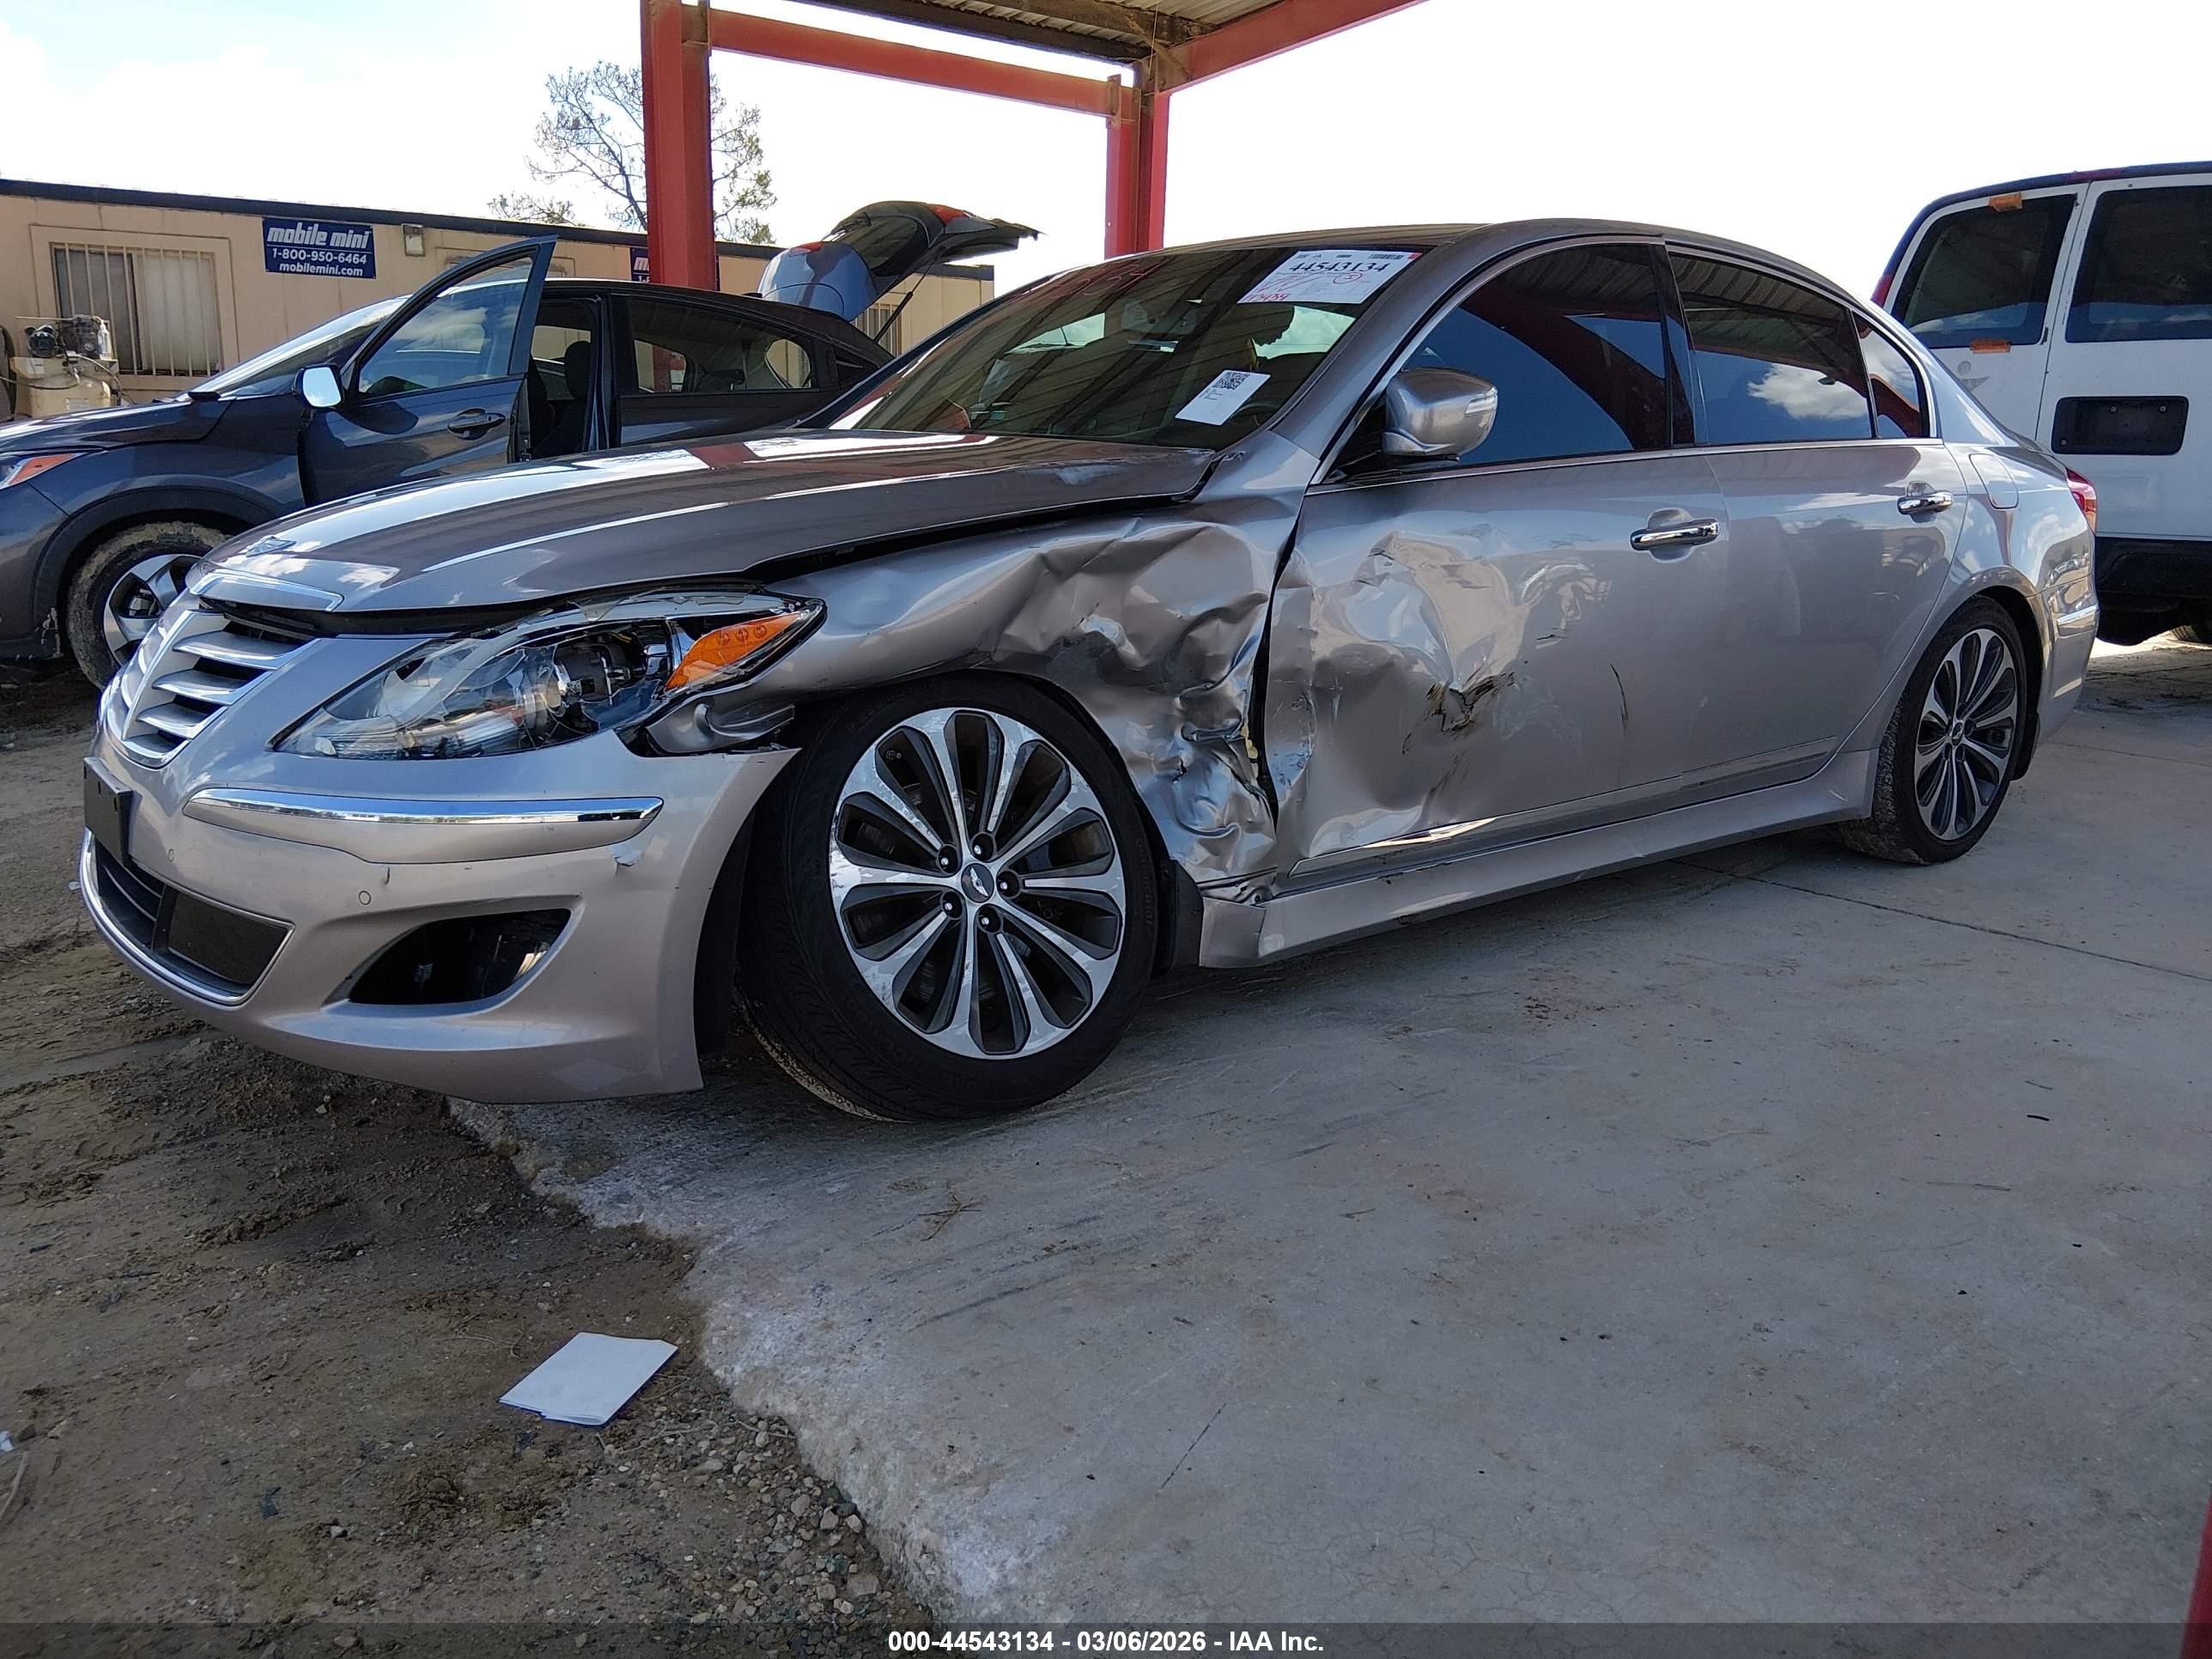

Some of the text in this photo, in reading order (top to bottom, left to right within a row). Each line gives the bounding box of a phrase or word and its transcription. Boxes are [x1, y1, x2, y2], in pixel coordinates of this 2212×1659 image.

[267, 222, 371, 249] mobile mini
[272, 248, 367, 264] 1-800-950-6464
[279, 262, 363, 276] mobilemini.com
[1289, 262, 1391, 272] 44543134
